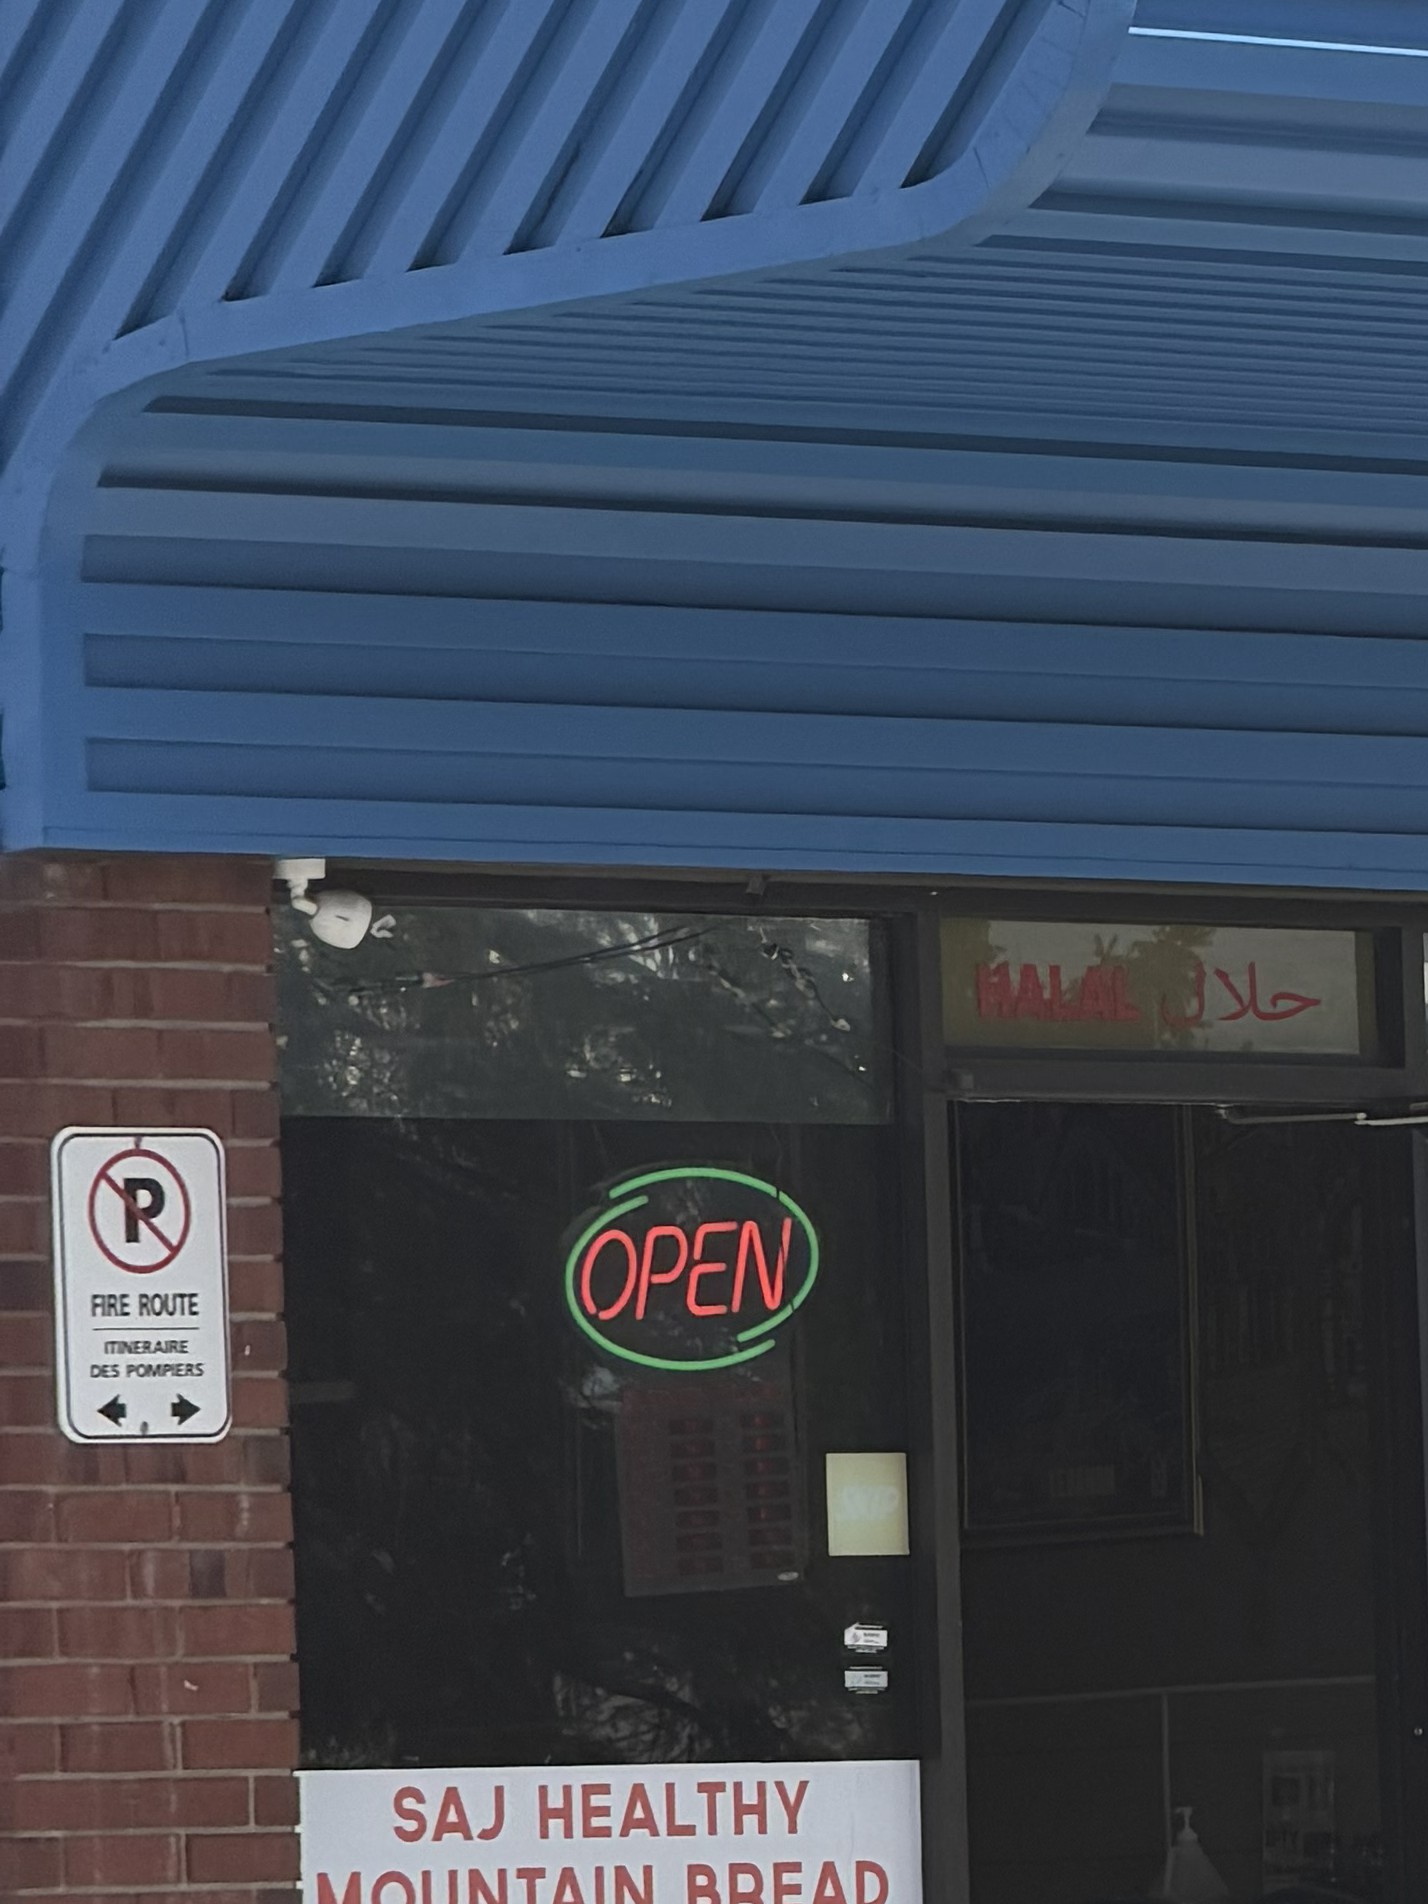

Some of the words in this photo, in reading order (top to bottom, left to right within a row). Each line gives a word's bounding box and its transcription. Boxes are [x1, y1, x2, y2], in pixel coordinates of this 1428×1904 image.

[975, 961, 1142, 1023] HALAL
[1162, 960, 1321, 1028] حلال
[580, 1219, 792, 1321] OPEN
[91, 1294, 131, 1317] FIRE
[138, 1293, 200, 1317] ROUTE
[90, 1364, 120, 1379] DES
[126, 1362, 205, 1378] POMPIERS
[392, 1786, 506, 1844] SAJ
[537, 1780, 810, 1840] HEALTHY
